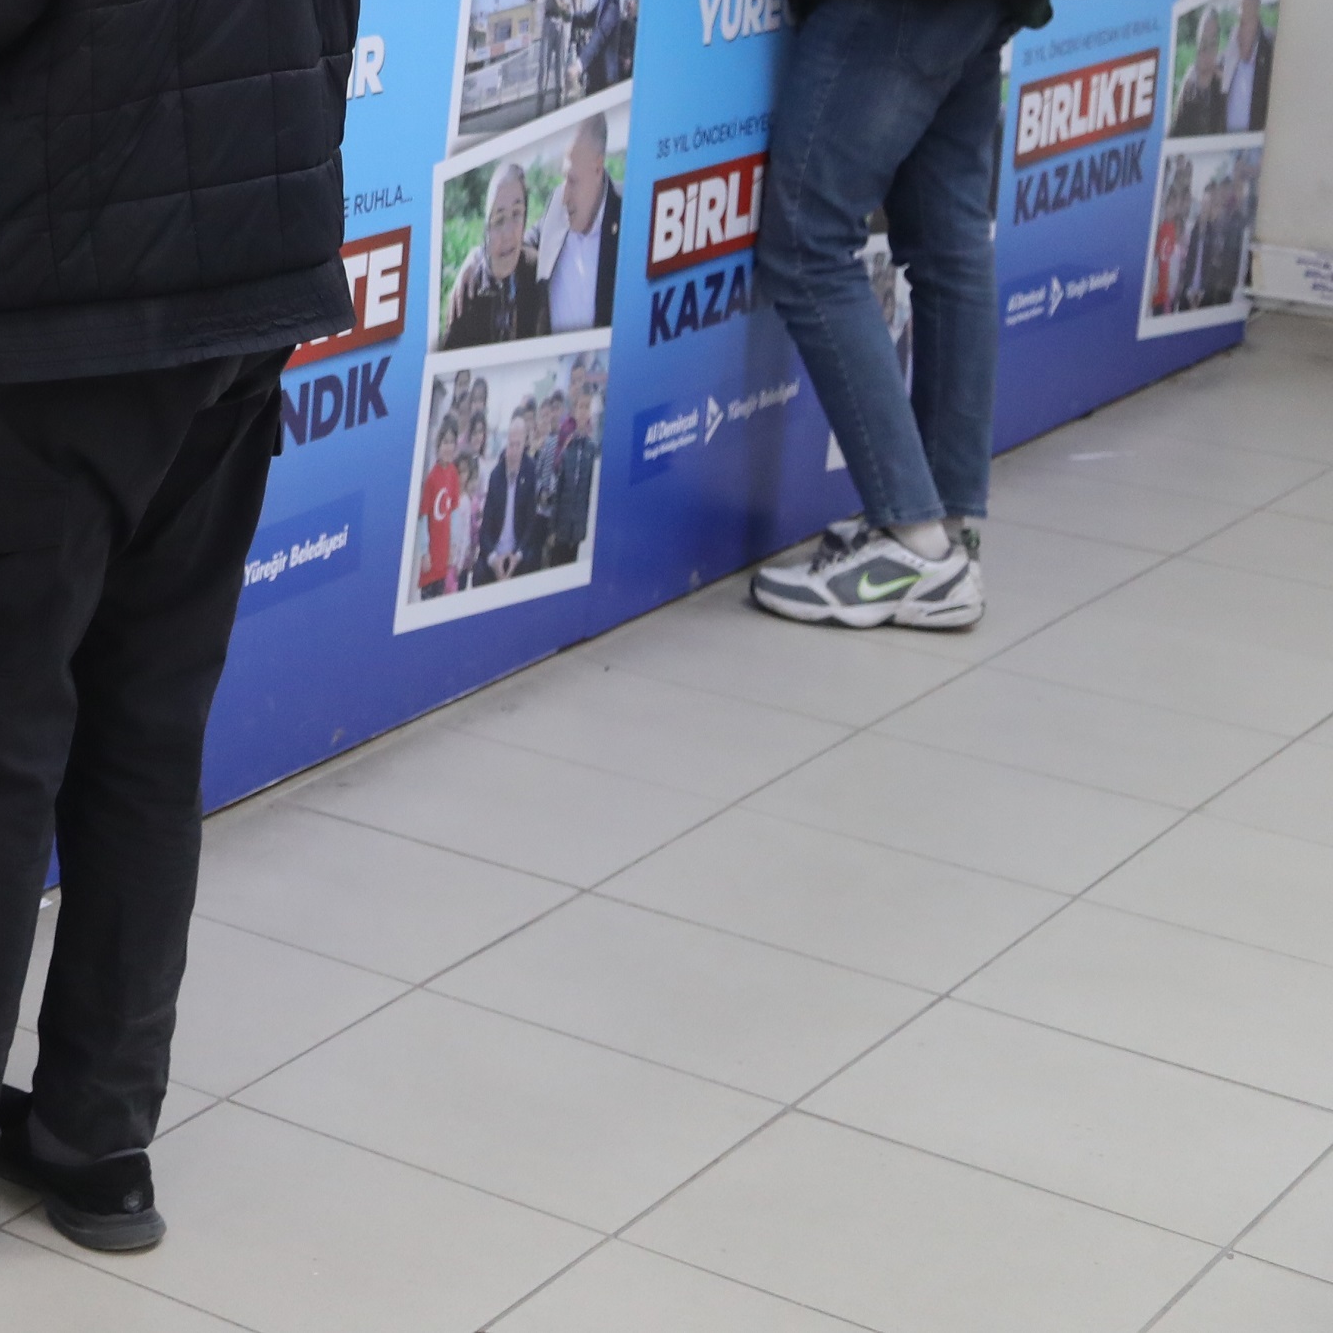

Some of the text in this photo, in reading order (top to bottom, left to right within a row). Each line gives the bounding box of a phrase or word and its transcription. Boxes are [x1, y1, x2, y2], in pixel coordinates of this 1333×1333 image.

[1016, 57, 1157, 157] BİRLİKTE
[651, 164, 765, 264] BİRLİ
[1013, 138, 1146, 225] KAZANDIK
[648, 264, 750, 348] KAZA
